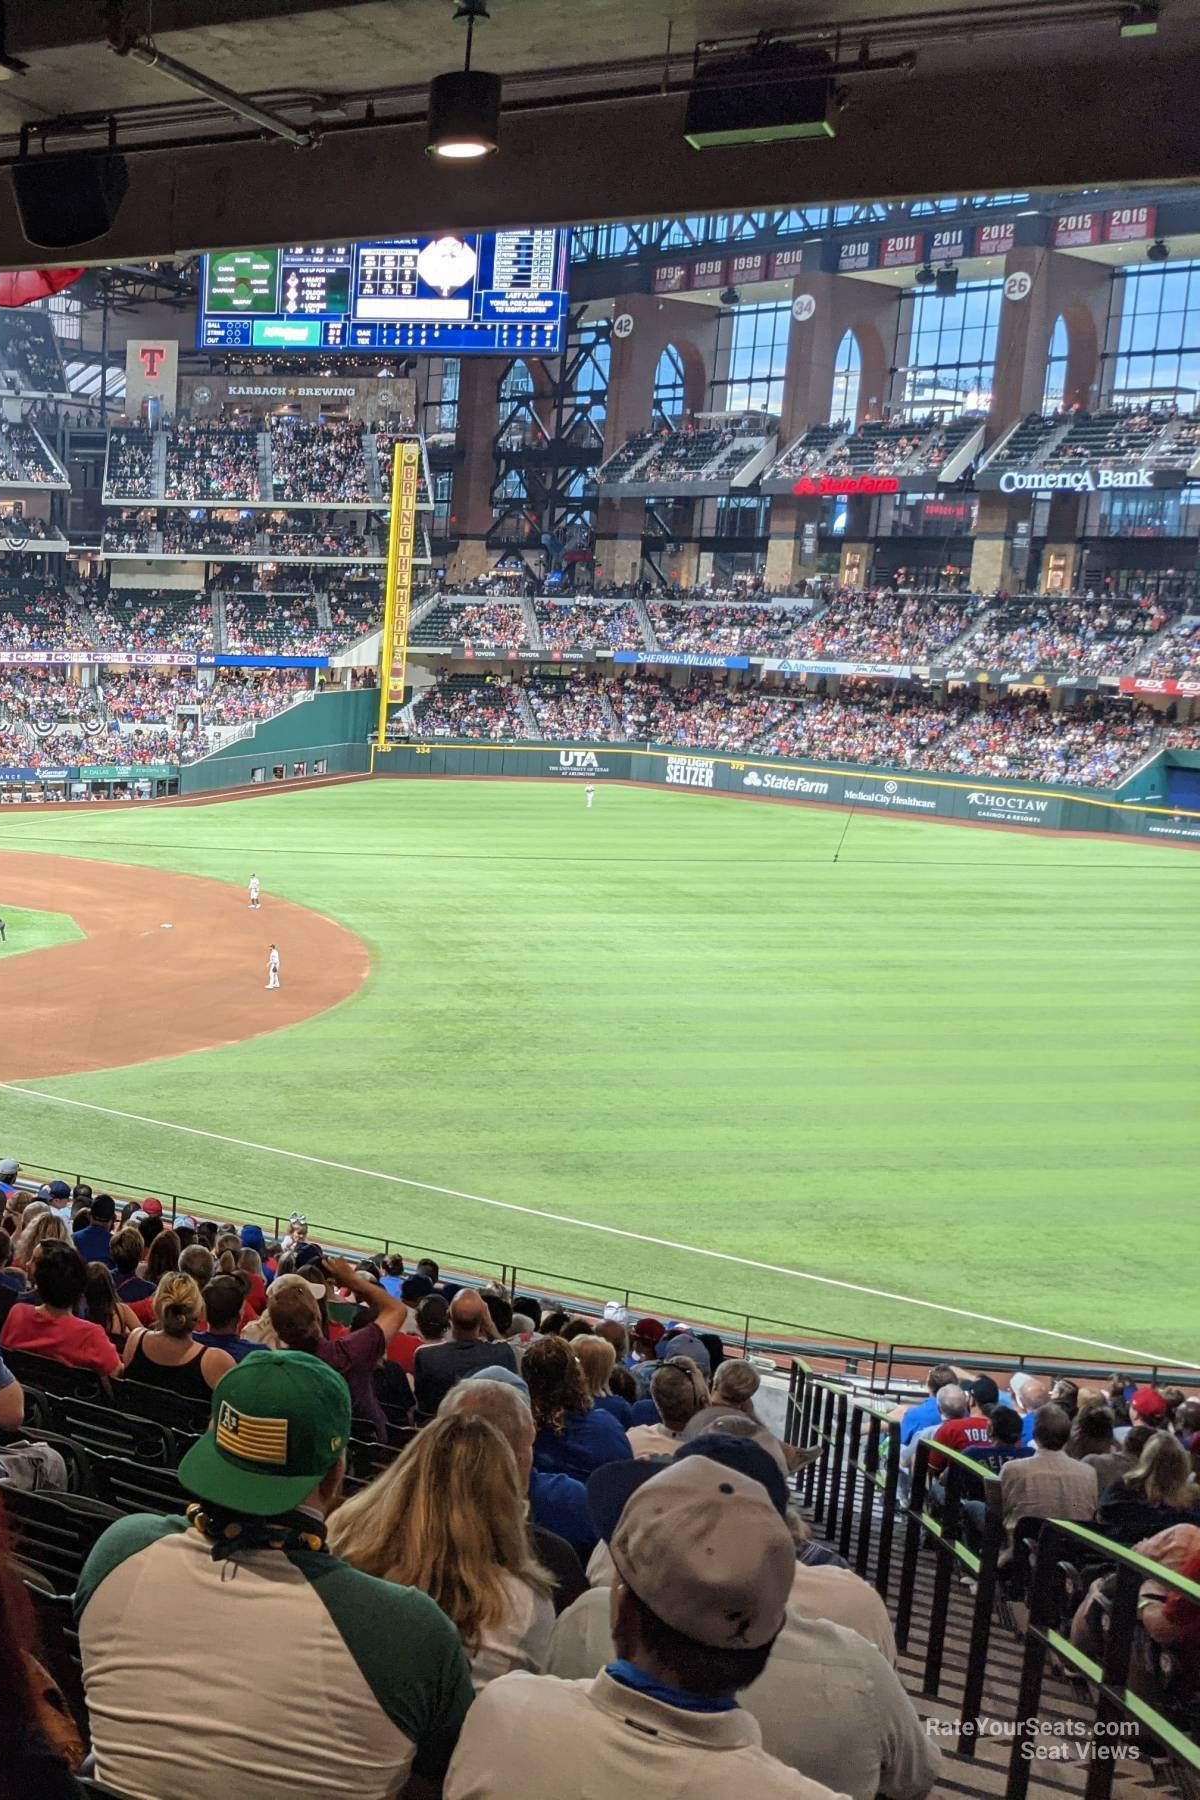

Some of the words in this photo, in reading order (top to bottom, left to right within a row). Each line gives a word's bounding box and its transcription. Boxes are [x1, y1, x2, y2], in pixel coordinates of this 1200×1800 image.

[1057, 214, 1092, 232] 2015
[1111, 207, 1148, 225] 2016
[933, 230, 963, 246] 2011
[982, 223, 1014, 241] 2012
[841, 242, 869, 258] 2010
[887, 235, 916, 252] 2011
[733, 255, 761, 271] 1999
[776, 249, 803, 265] 2010
[695, 261, 722, 275] 1998
[1007, 277, 1028, 296] 26
[795, 300, 813, 316] 34
[616, 318, 631, 334] 42
[140, 347, 166, 381] T
[228, 386, 287, 396] KARBACH
[298, 387, 356, 396] BREWING
[1097, 468, 1155, 487] Bank
[402, 467, 414, 538] BRING
[399, 543, 409, 585] THE
[396, 590, 406, 645] HEAT
[794, 663, 837, 673] Albertsons
[1134, 679, 1165, 688] DEX
[1176, 681, 1200, 690] DE
[416, 746, 431, 754] 334
[559, 751, 599, 767] UTA
[668, 756, 687, 766] BUD
[688, 758, 715, 768] LIGHT
[730, 761, 745, 771] 372
[666, 765, 714, 788] SELTZER
[844, 790, 874, 801] Medical
[875, 793, 891, 805] City
[892, 796, 936, 808] Healthcare
[970, 793, 1048, 811] CHOCTAW
[964, 1428, 993, 1443] YOU
